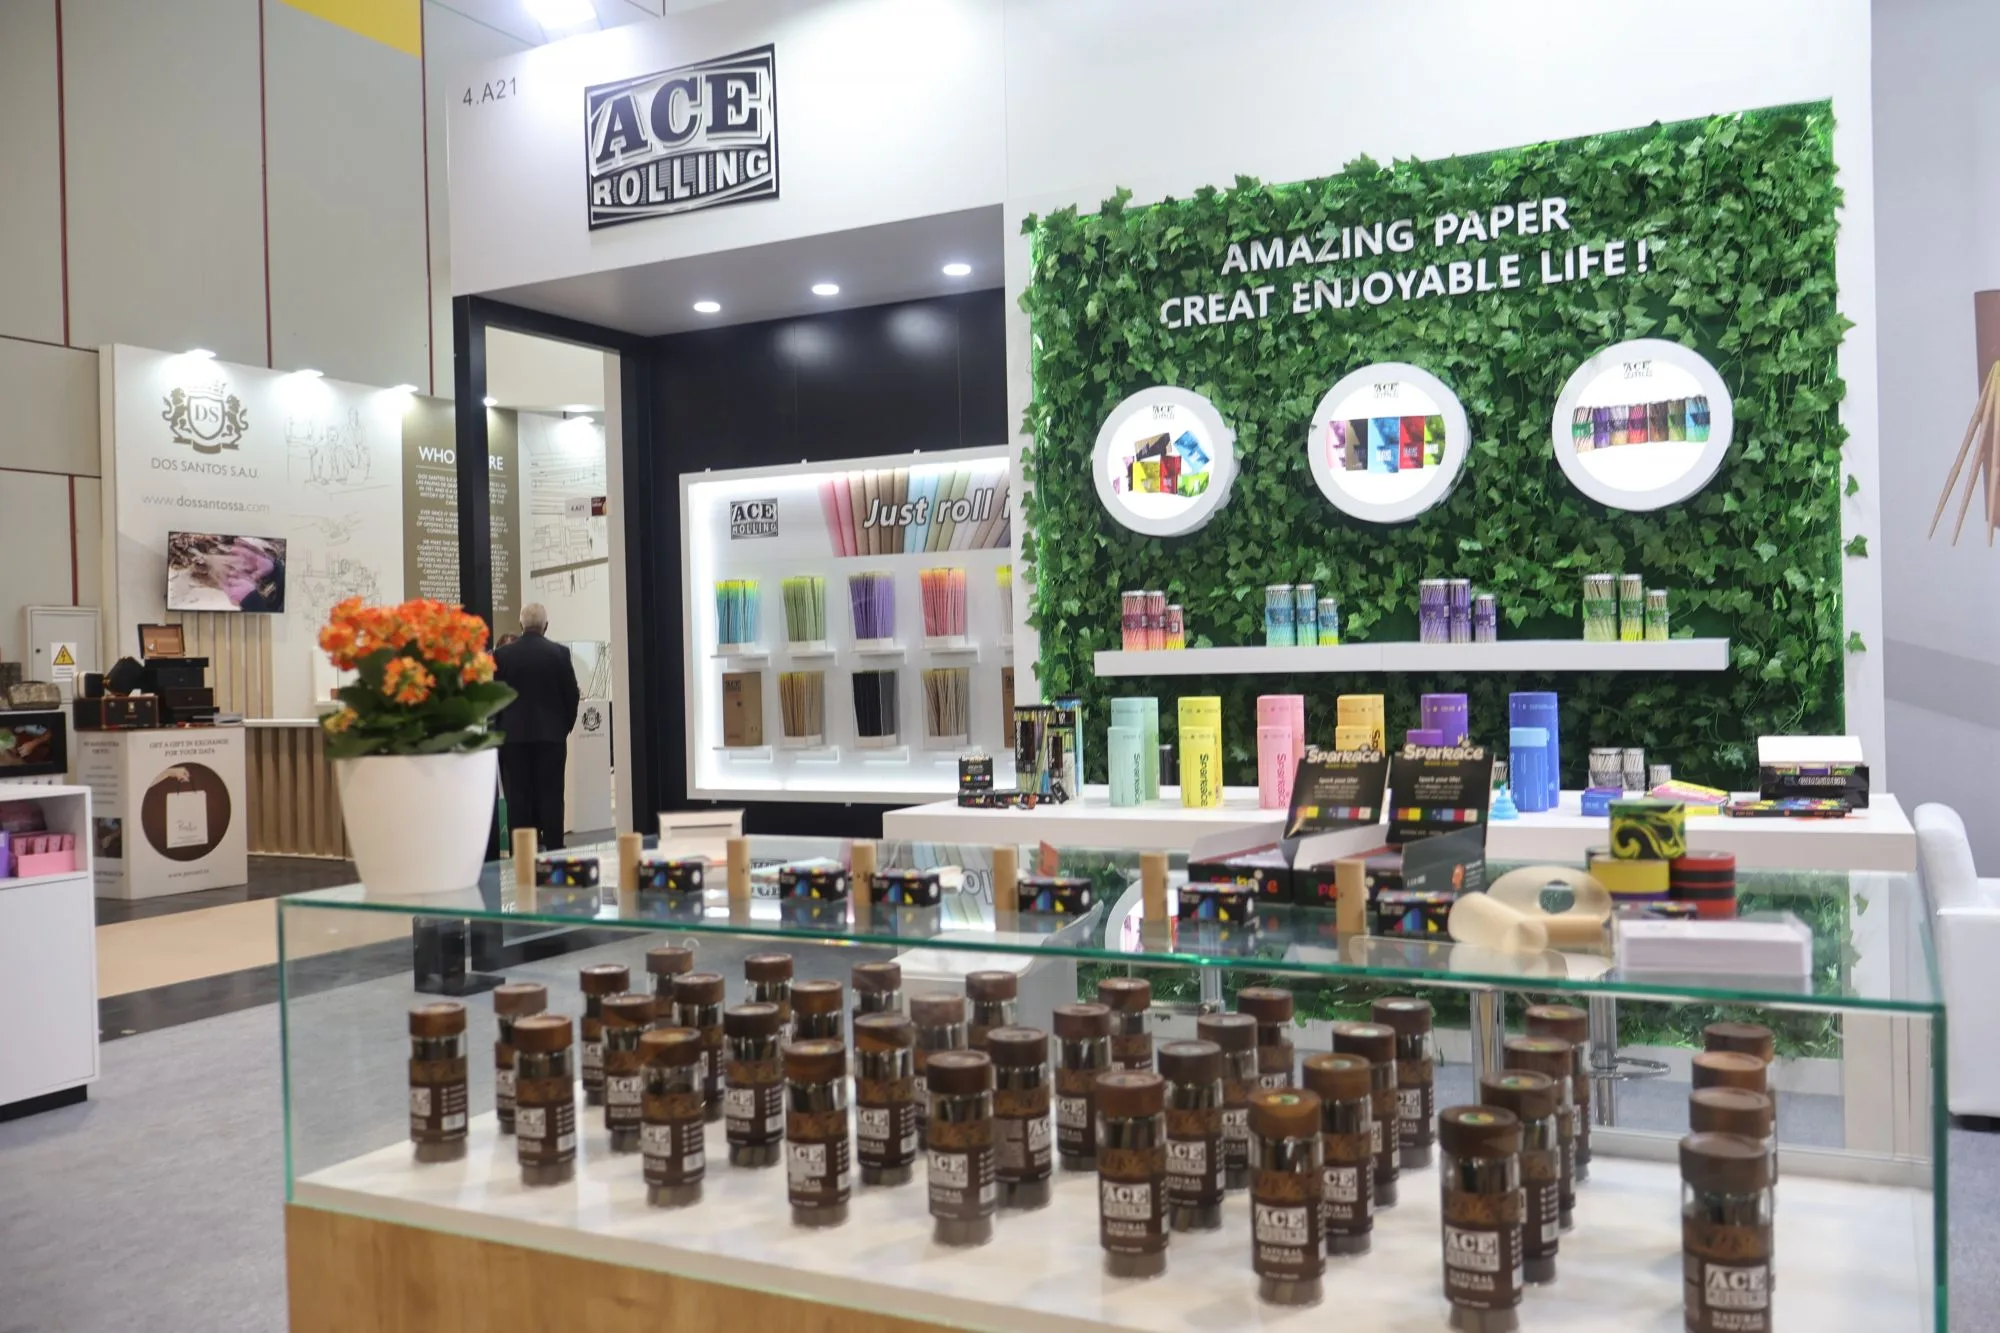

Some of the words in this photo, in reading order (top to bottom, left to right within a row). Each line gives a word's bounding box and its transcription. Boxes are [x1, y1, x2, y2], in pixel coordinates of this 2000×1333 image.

[462, 76, 518, 107] 4.A21
[596, 71, 765, 163] ACE
[593, 149, 770, 207] ROLLING
[1221, 218, 1415, 277] AMAZING
[1434, 197, 1570, 245] PAPER
[1160, 285, 1275, 329] CREAT
[1292, 253, 1521, 313] ENJOYABLE
[195, 404, 219, 423] DS
[151, 457, 178, 471] DOS
[181, 461, 227, 476] SANTOS
[230, 467, 259, 479] S.A.U.
[418, 446, 455, 464] WHO
[488, 455, 504, 471] RE
[733, 503, 774, 522] ACE
[863, 496, 928, 529] Just
[937, 489, 991, 523] roll
[733, 523, 777, 535] ROLLING
[1307, 746, 1380, 764] Sparkace
[1404, 743, 1484, 761] Sparkace
[1104, 1186, 1148, 1205] ACE
[1256, 1208, 1305, 1229] ACE
[1445, 1232, 1496, 1255] ACE
[1709, 1271, 1766, 1291] ACE
